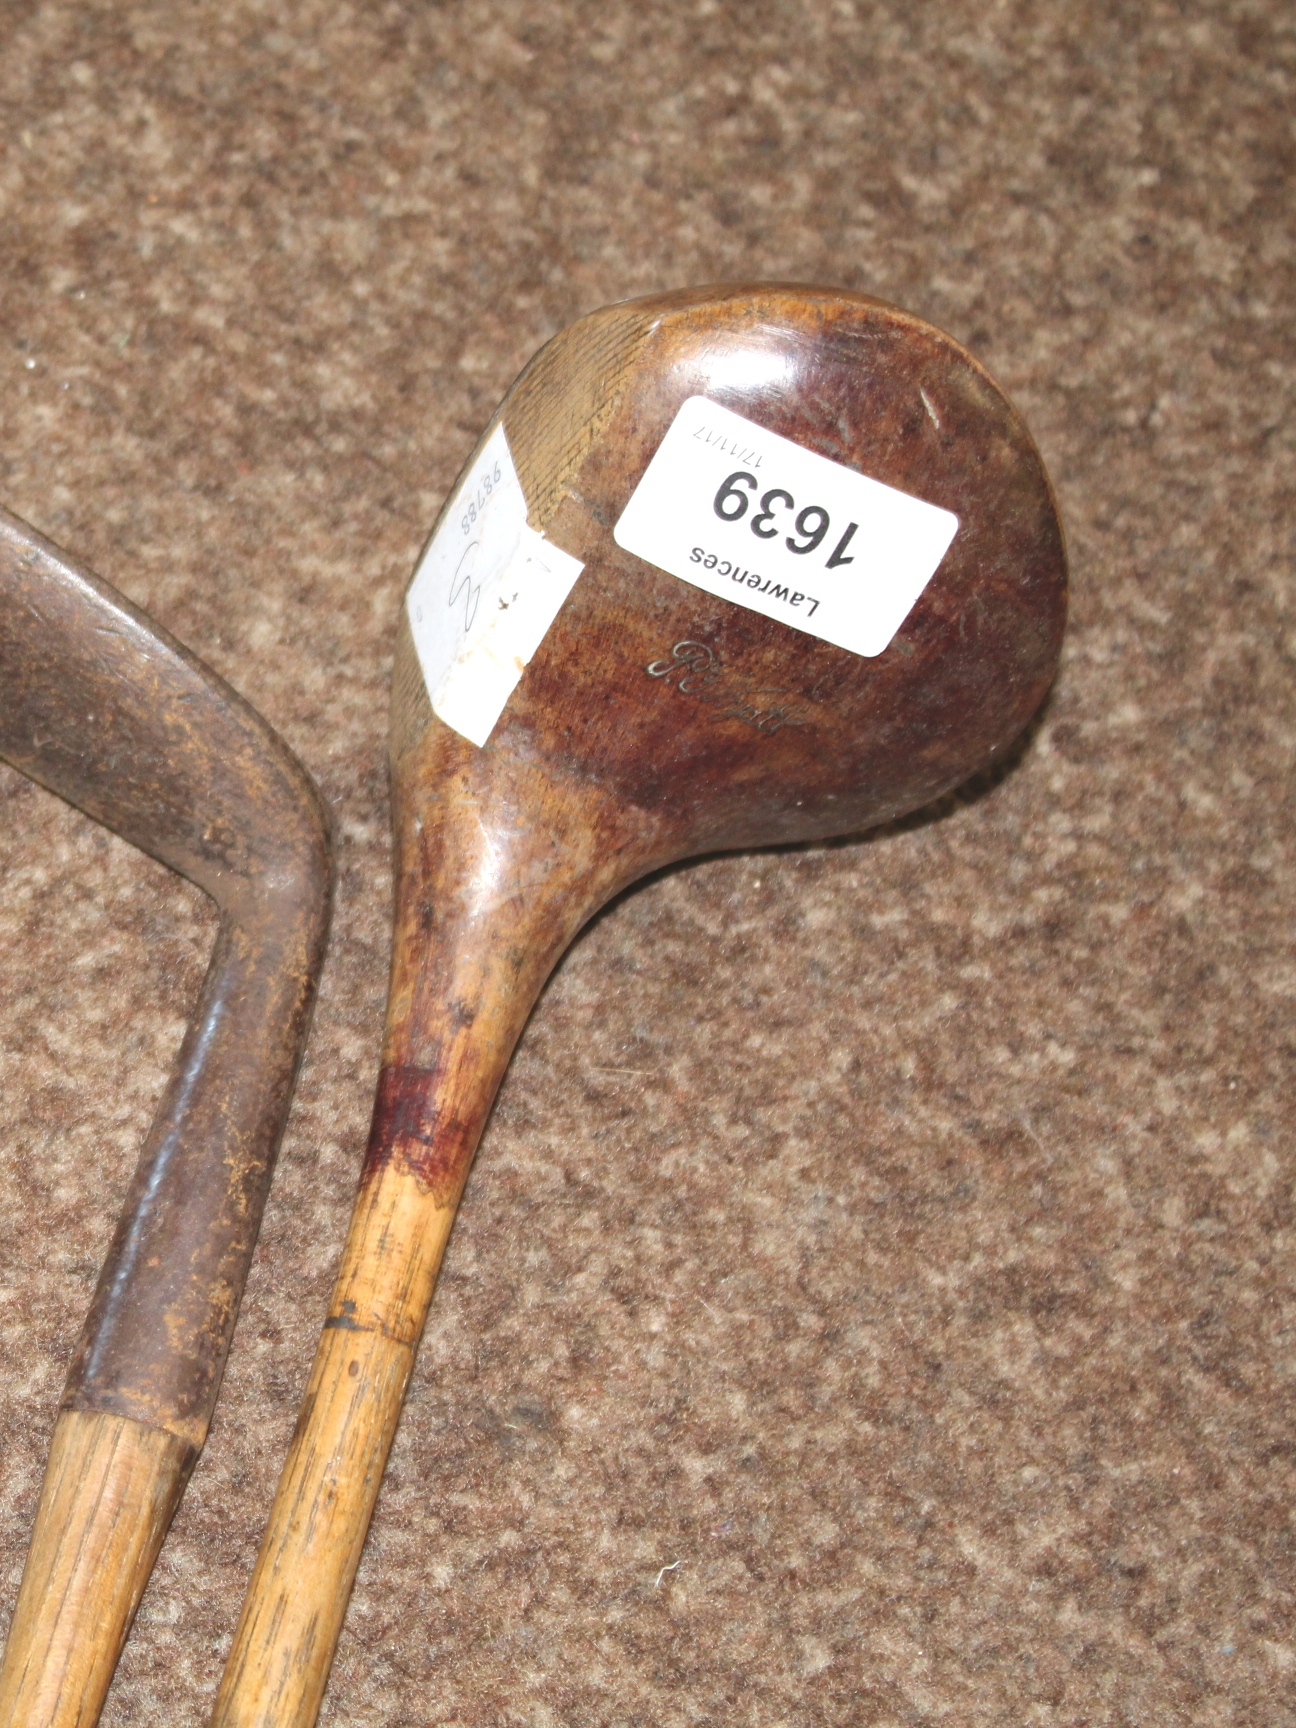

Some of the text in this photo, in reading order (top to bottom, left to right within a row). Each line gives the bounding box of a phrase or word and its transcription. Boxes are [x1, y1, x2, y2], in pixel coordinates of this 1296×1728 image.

[692, 426, 764, 469] 17/11/17
[712, 470, 860, 571] 1639
[688, 545, 822, 619] Lawrences
